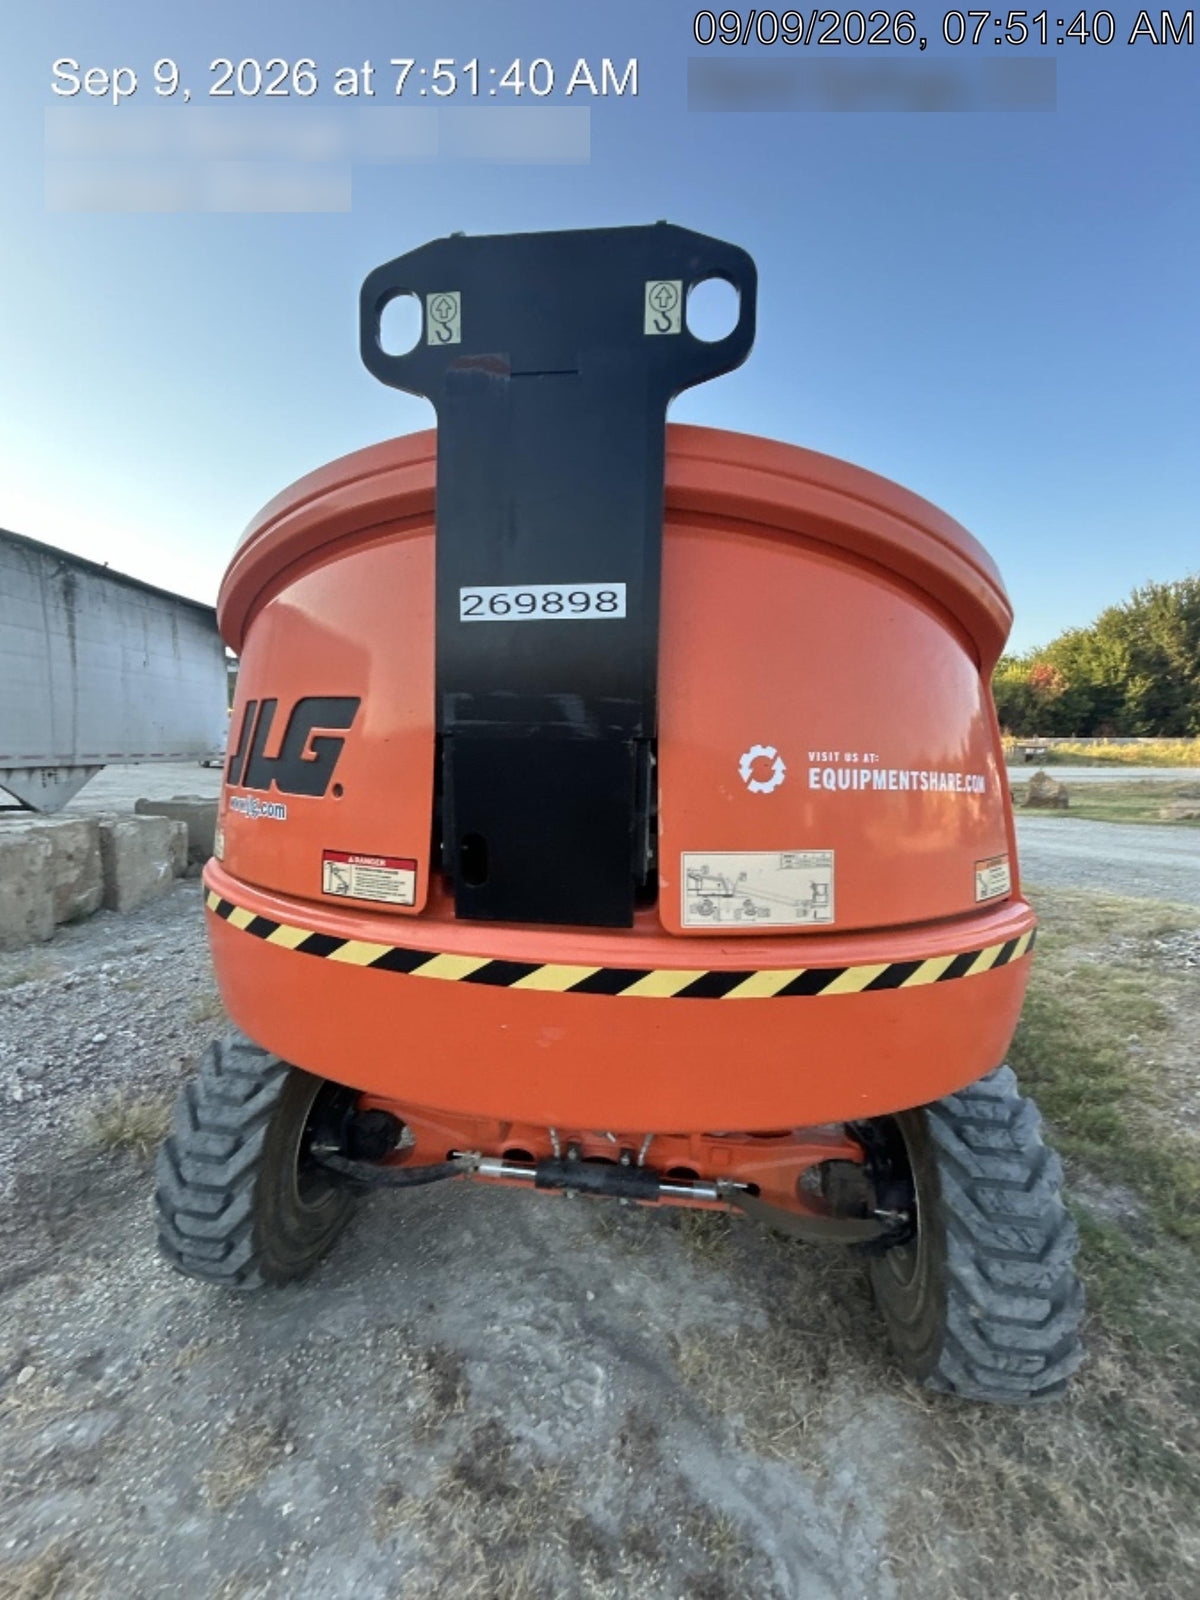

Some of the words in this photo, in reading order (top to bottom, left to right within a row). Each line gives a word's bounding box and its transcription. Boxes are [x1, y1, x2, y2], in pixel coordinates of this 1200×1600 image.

[462, 591, 618, 616] 269898
[808, 751, 840, 762] VISIT
[844, 752, 859, 762] US
[863, 752, 880, 764] AT:
[809, 768, 985, 793] EQUIPMENTSHARE.COM
